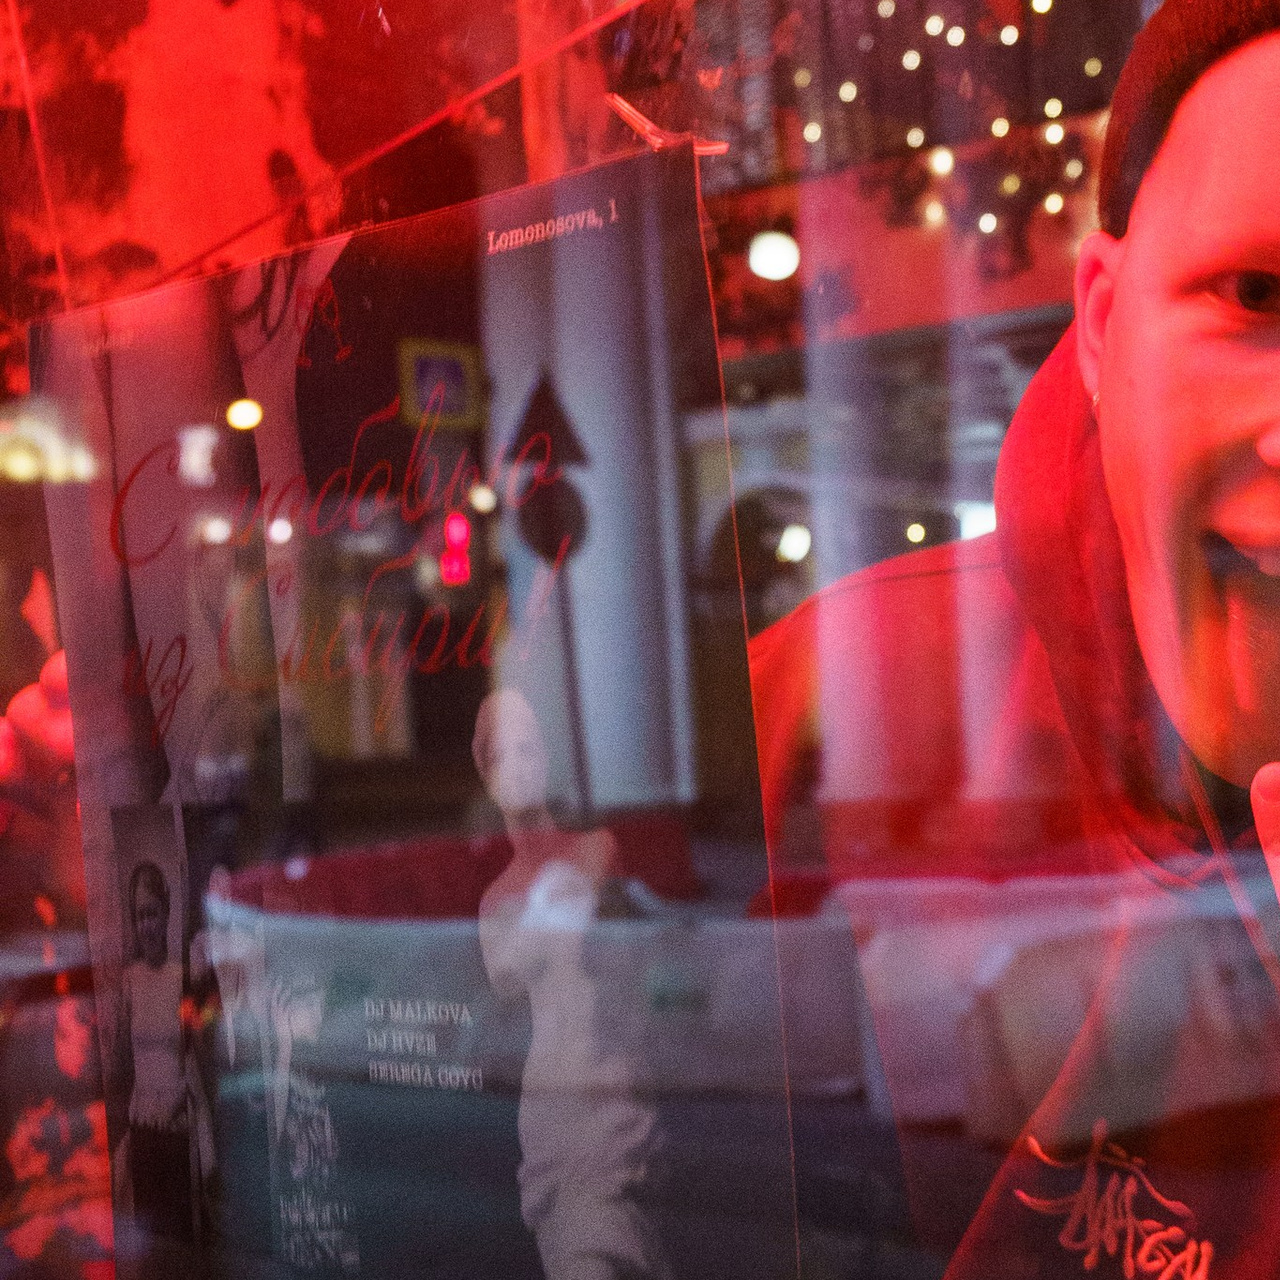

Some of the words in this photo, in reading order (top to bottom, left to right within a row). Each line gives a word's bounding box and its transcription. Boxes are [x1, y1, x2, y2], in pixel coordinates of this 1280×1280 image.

[485, 207, 605, 257] Lomonosova,
[607, 196, 621, 224] 1
[363, 996, 385, 1021] DJ
[388, 997, 474, 1028] MALKOVA
[365, 1027, 387, 1053] DJ
